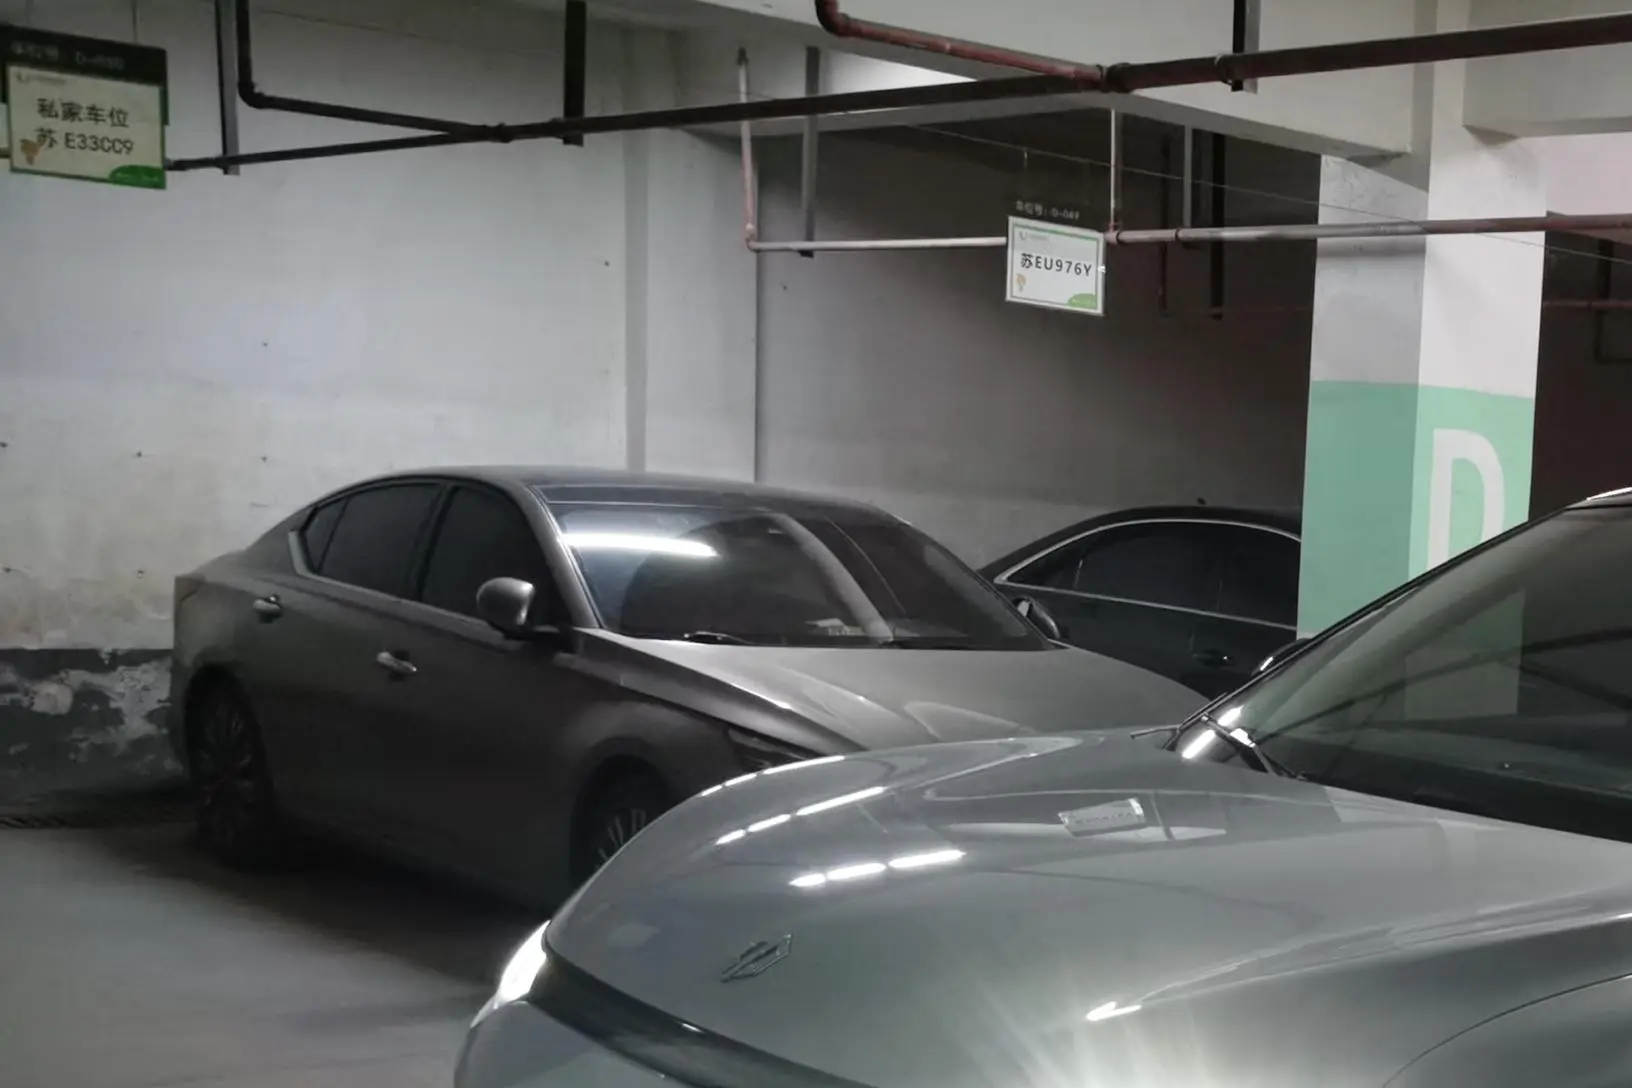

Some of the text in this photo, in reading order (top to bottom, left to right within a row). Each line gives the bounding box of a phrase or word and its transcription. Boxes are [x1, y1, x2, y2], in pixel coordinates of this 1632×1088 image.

[37, 98, 130, 128] 私家车位
[1020, 252, 1092, 277] 苏EU976Y
[1426, 428, 1505, 571] D
